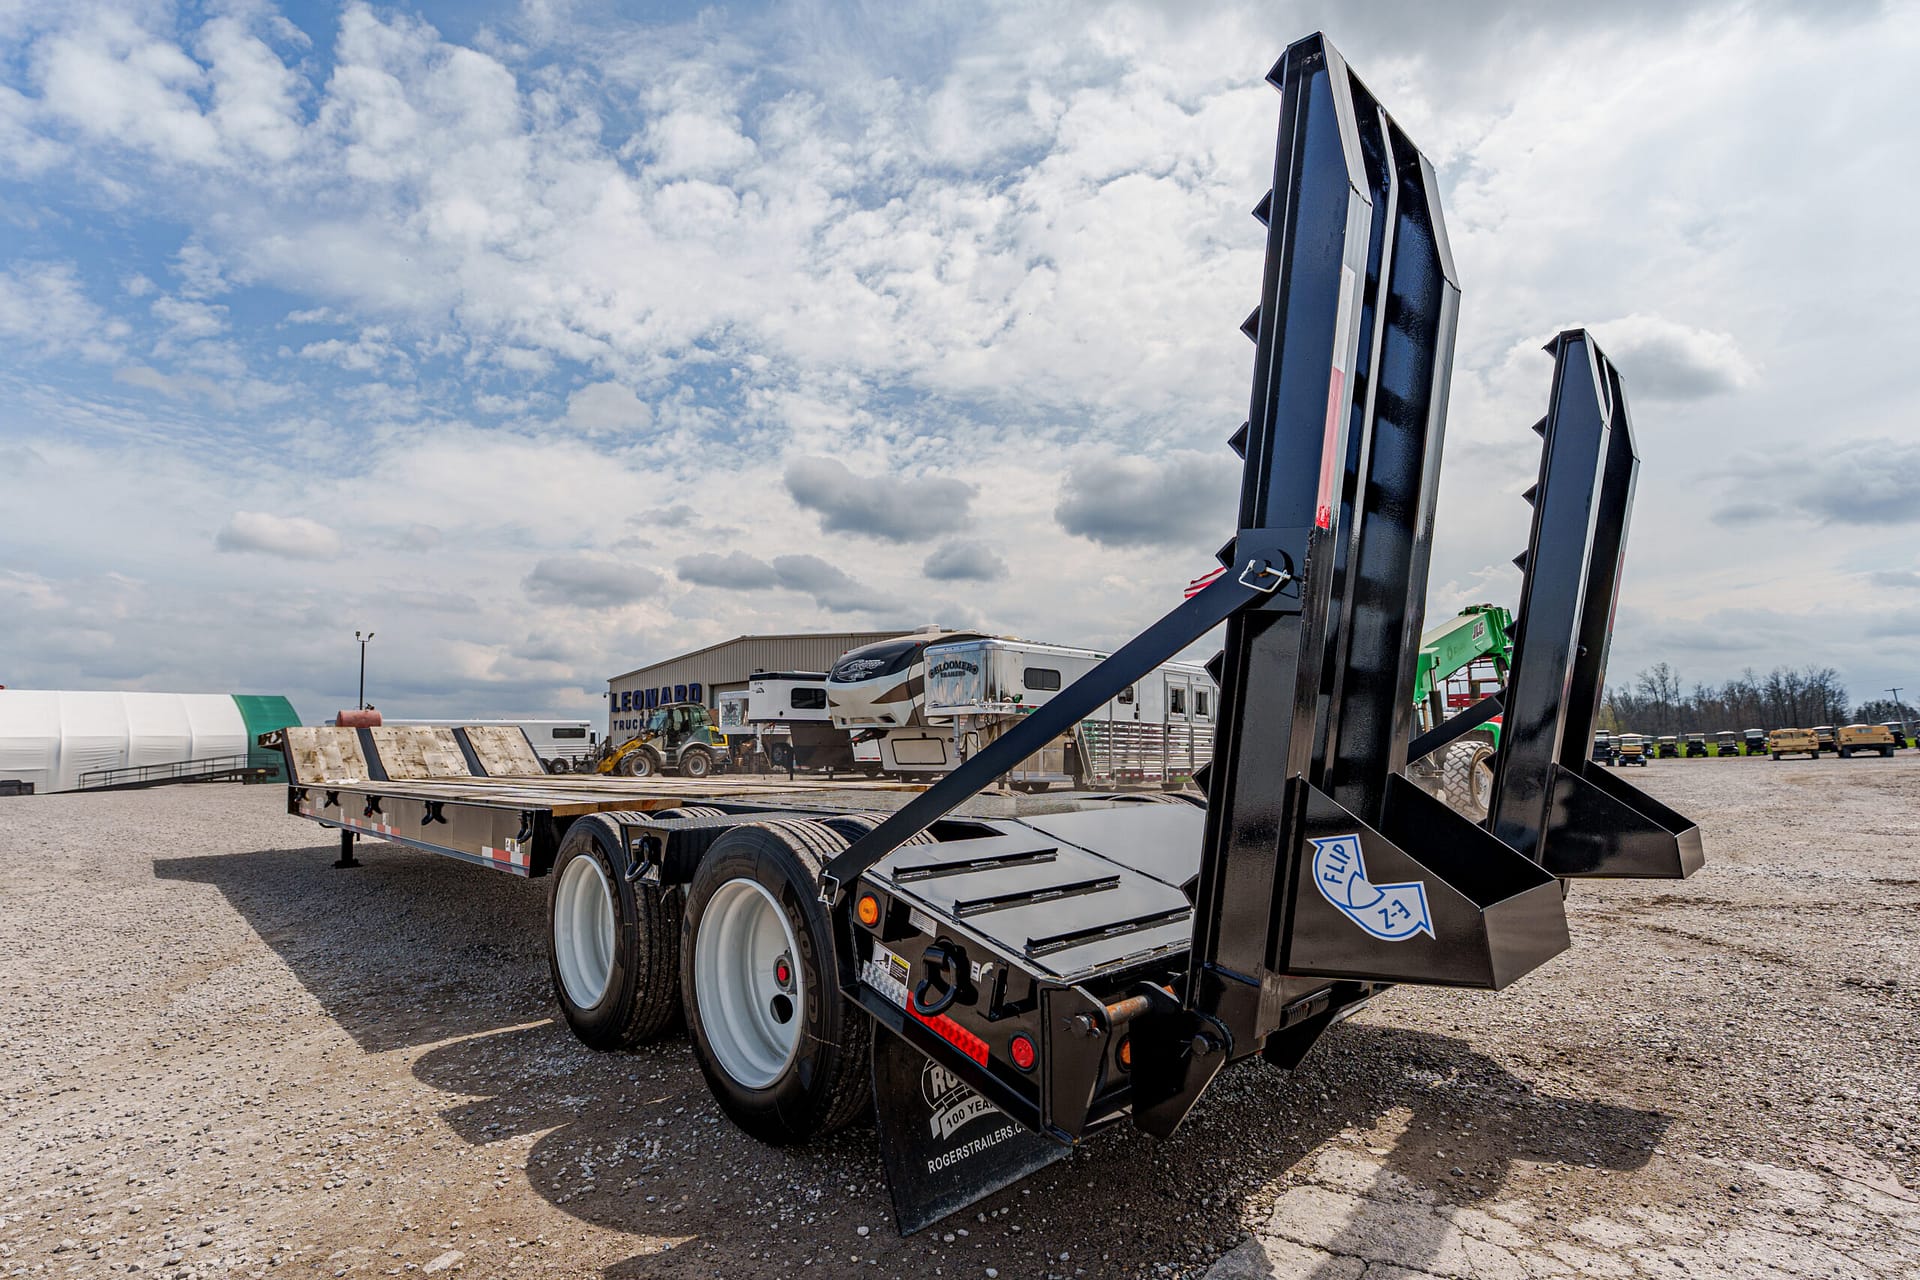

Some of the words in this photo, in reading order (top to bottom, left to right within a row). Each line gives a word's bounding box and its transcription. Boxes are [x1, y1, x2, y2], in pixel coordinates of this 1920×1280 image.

[1473, 621, 1484, 640] JLG
[934, 660, 973, 674] BLOOMER
[940, 670, 966, 678] TRAILERS
[611, 683, 702, 713] LEONARD
[1323, 843, 1351, 885] FLIP
[946, 1110, 965, 1129] 100
[967, 1100, 994, 1115] YEA
[927, 1122, 1026, 1174] ROGERSTRAILERS.C
